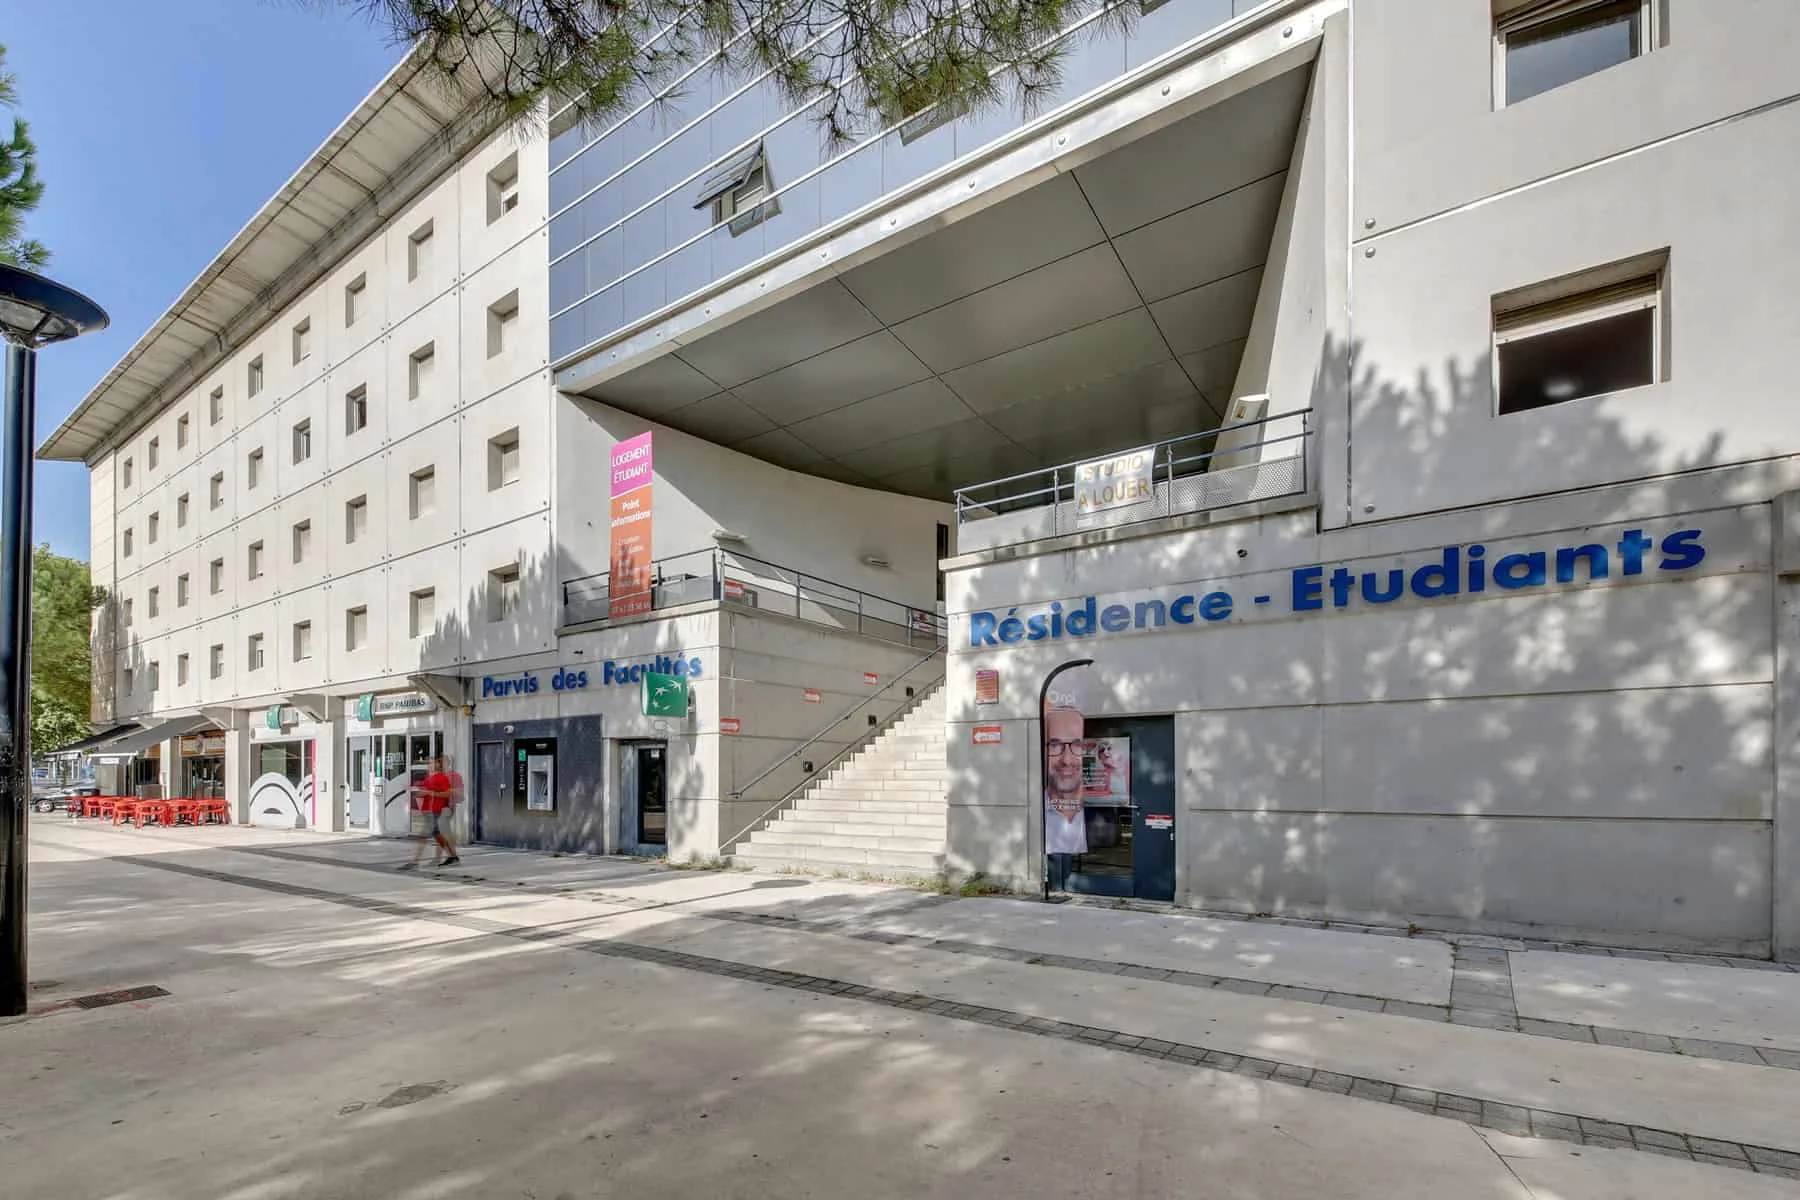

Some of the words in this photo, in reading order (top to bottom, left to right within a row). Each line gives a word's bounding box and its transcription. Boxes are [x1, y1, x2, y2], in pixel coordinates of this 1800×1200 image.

[611, 445, 649, 468] LOGEMENT
[1083, 455, 1144, 481] STUDIO
[622, 499, 641, 513] Point
[1079, 493, 1089, 509] A
[1093, 478, 1150, 506] LOUER
[970, 591, 1233, 648] Résidence
[1291, 529, 1706, 611] Etudiants
[481, 672, 538, 698] Parvis
[551, 667, 589, 690] des
